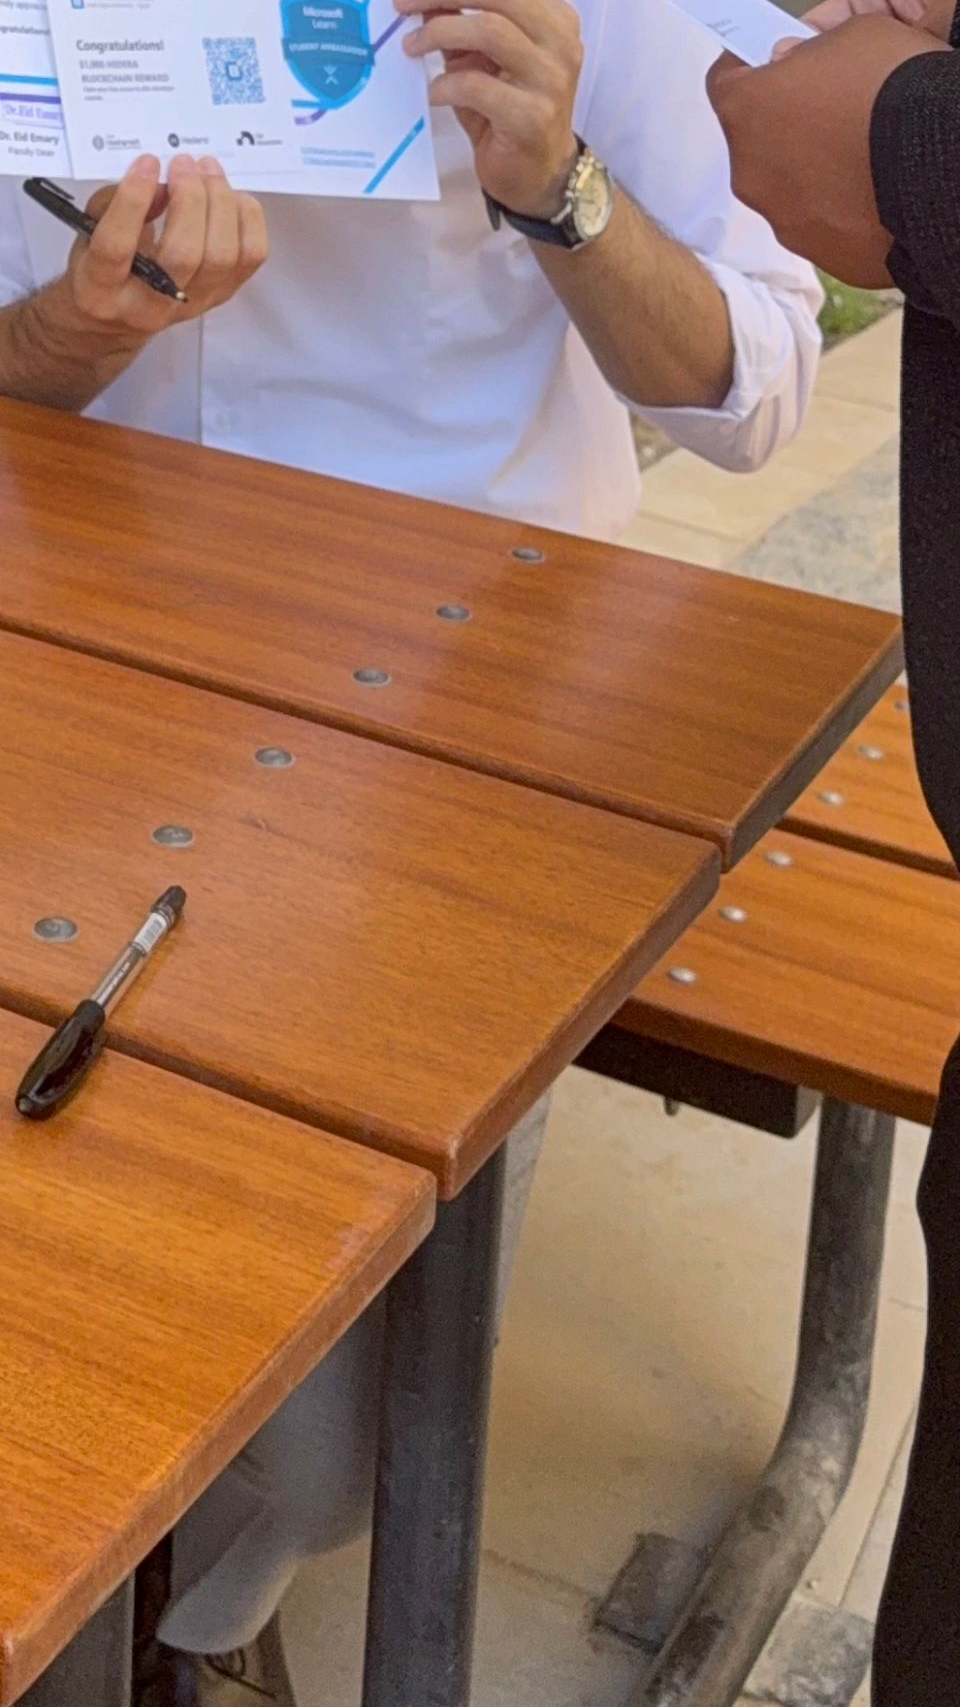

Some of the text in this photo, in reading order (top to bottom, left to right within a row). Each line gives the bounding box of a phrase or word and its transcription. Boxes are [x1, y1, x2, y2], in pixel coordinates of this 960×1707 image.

[302, 5, 344, 29] Microsoft Learn
[76, 39, 164, 55] Congratulations!
[13, 131, 28, 143] Eid
[30, 133, 59, 146] Emary
